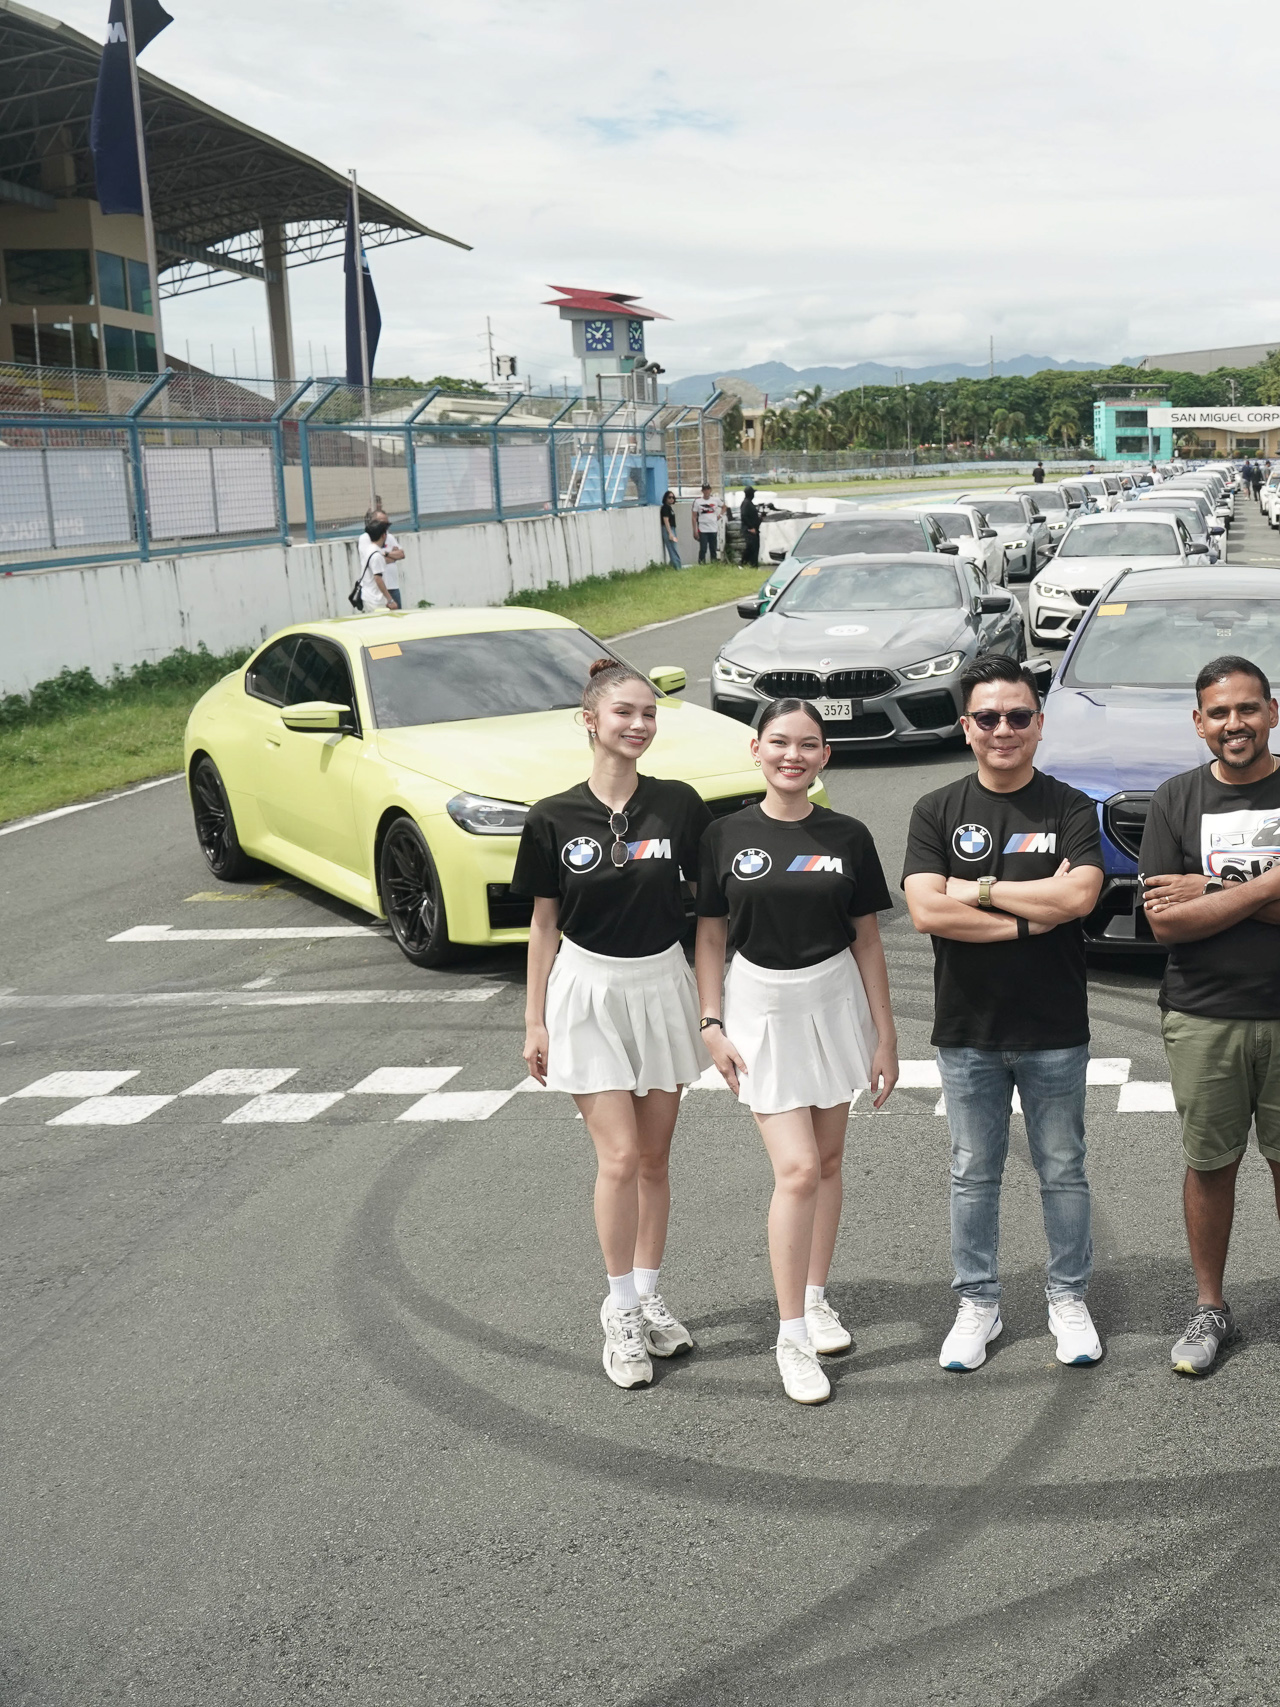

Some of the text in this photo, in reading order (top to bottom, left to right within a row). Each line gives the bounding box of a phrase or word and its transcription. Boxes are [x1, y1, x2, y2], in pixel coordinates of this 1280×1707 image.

[1170, 413, 1196, 423] SAN
[1199, 412, 1244, 423] MIGUEL
[824, 704, 850, 716] 3573
